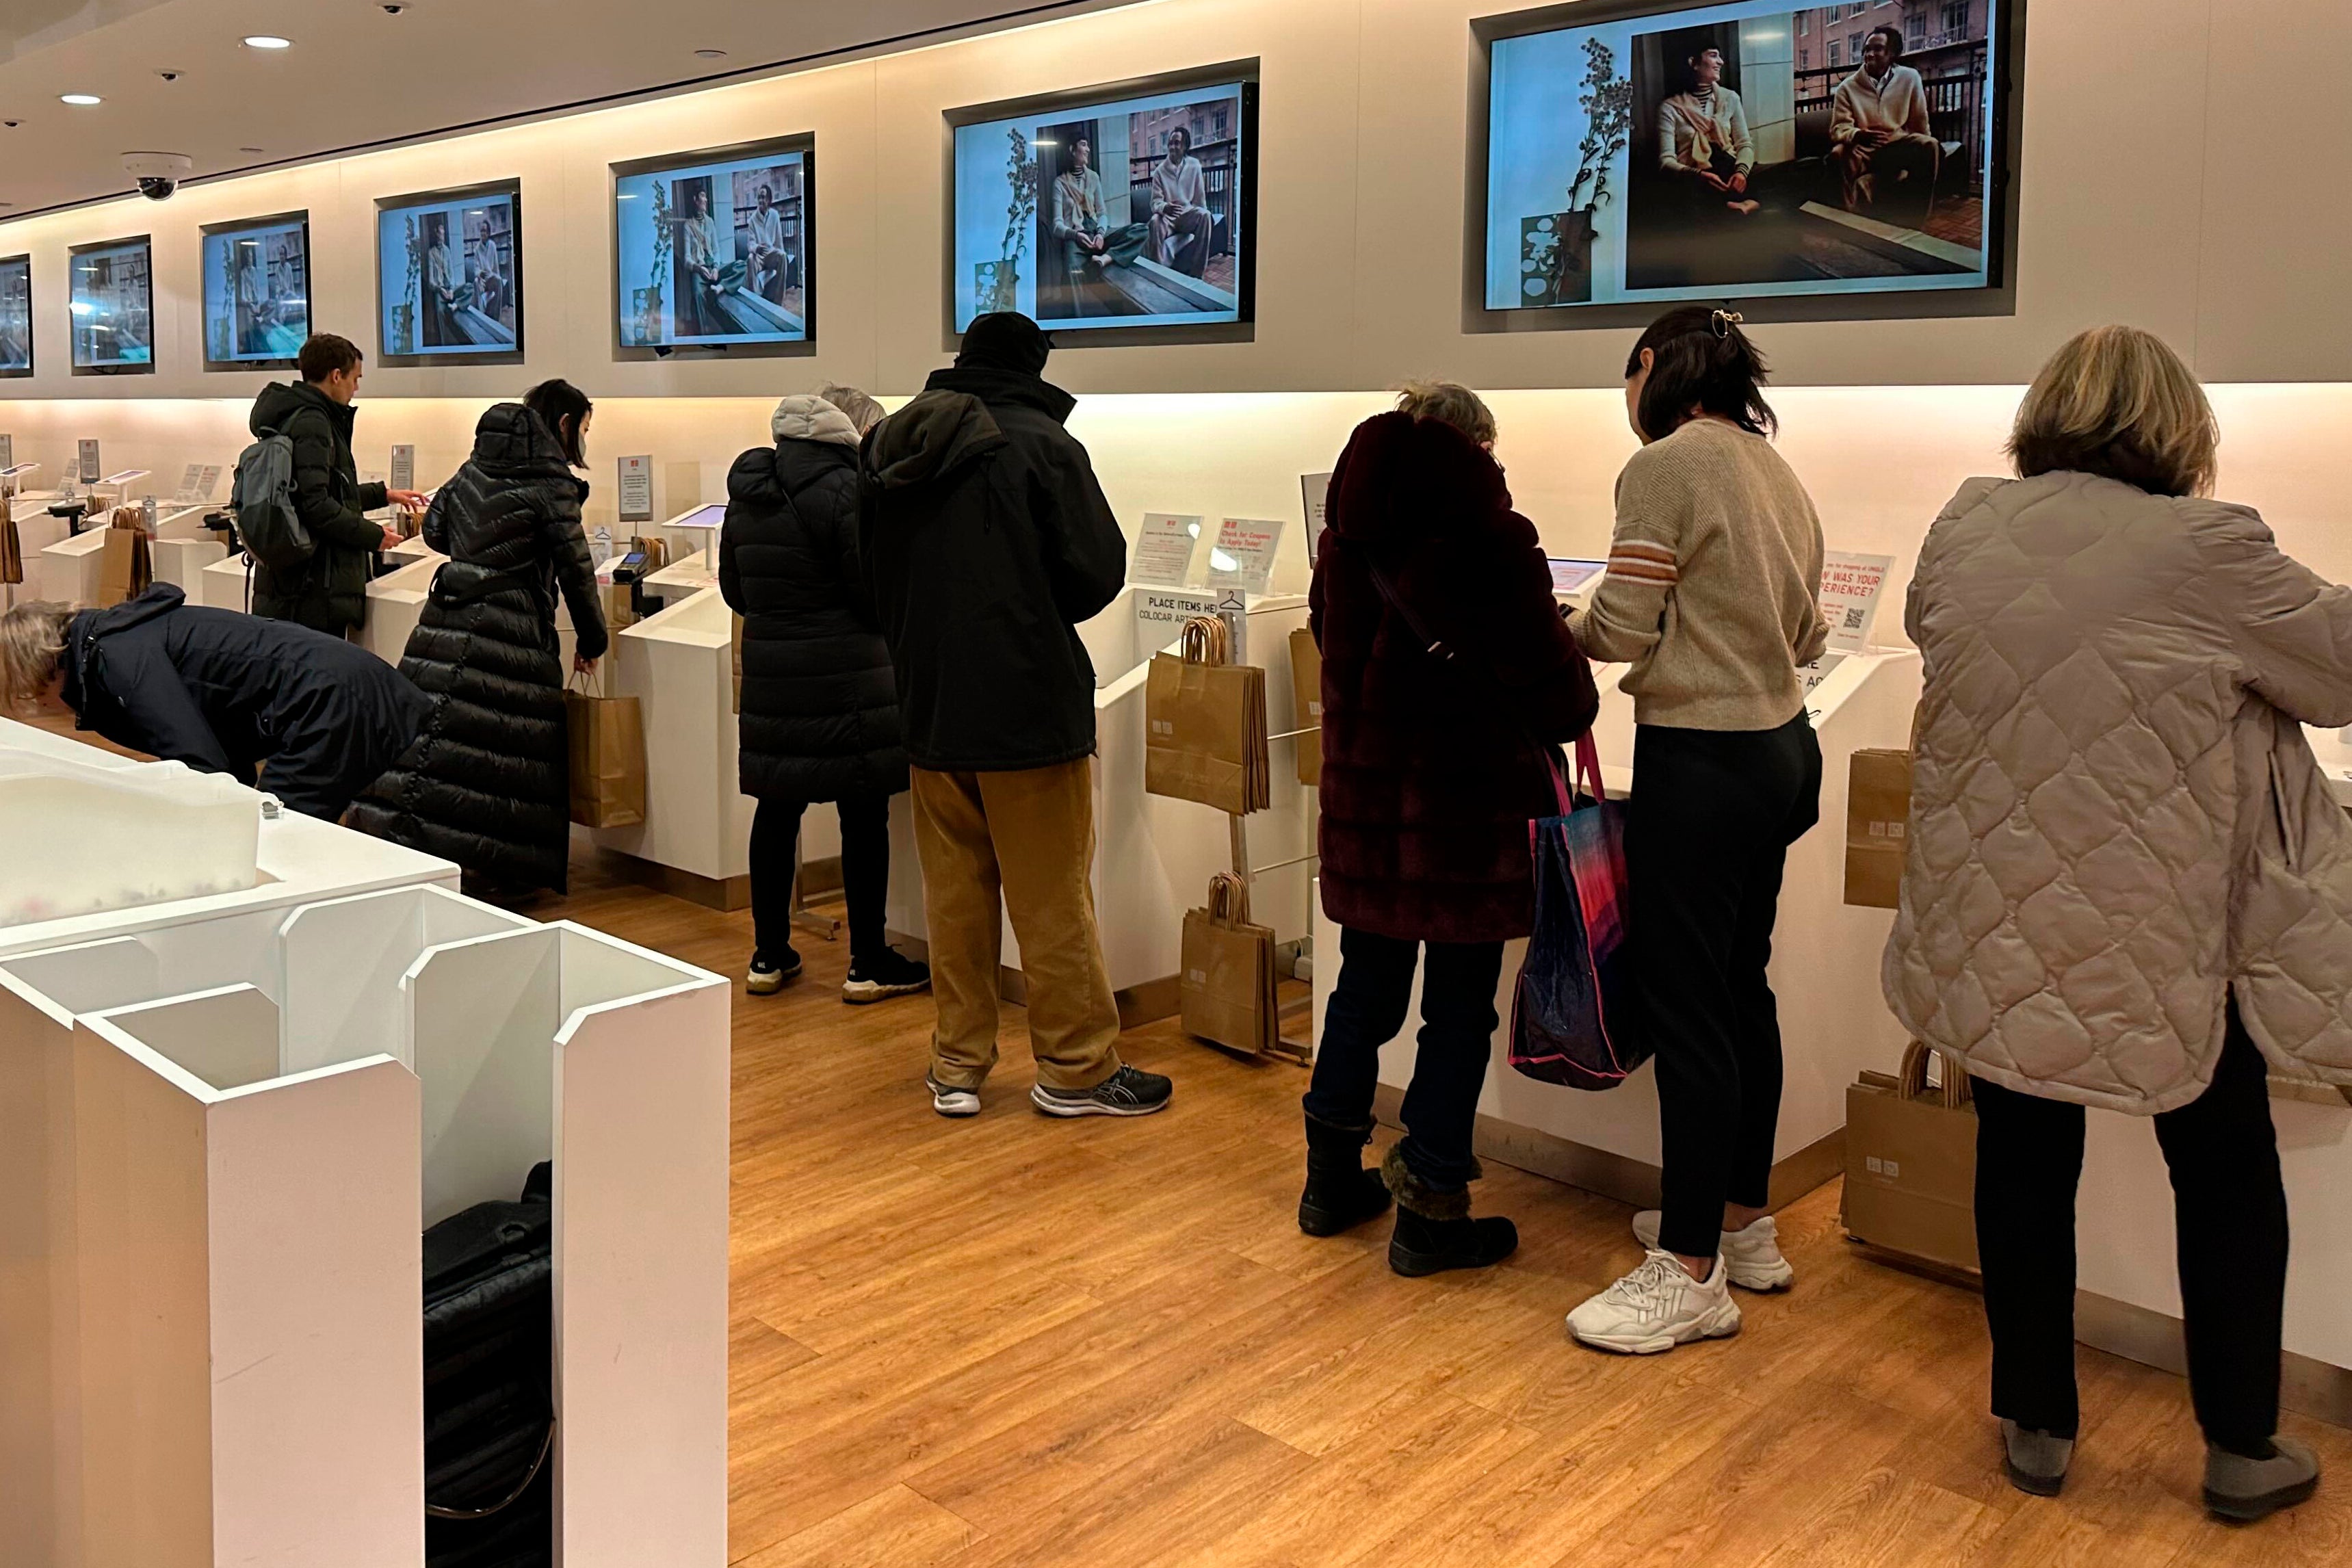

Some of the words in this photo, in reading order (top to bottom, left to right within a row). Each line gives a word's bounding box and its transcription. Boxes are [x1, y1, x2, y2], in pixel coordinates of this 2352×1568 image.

[1833, 571, 1853, 582] WAS
[1857, 574, 1881, 586] YOUR
[1149, 597, 1175, 609] PLACE
[1177, 600, 1201, 612] ITEMS
[1204, 603, 1217, 614] HE
[1139, 610, 1173, 622] COLOCAR
